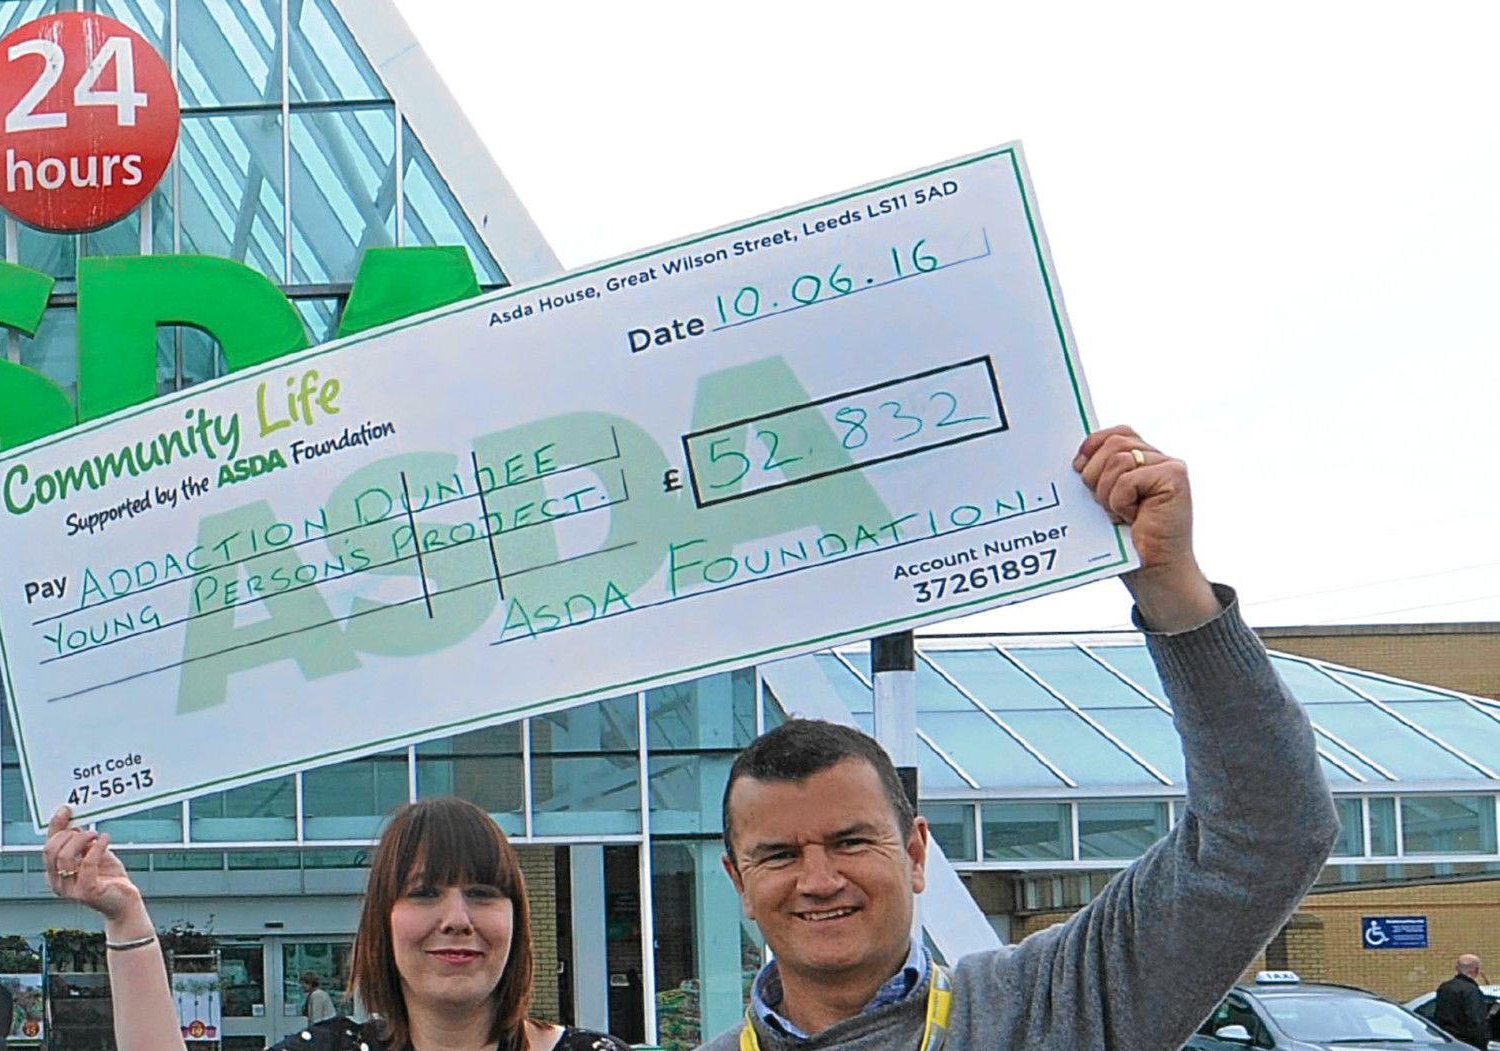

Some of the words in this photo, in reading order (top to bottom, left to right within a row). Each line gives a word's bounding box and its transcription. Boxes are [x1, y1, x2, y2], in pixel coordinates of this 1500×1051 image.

[4, 36, 148, 133] 24
[5, 148, 143, 192] hours
[488, 304, 534, 327] Asda
[538, 286, 600, 313] House,
[606, 267, 658, 292] Great
[662, 247, 728, 275] Wilson
[732, 228, 798, 256] Street,
[802, 210, 862, 237] Leeds
[867, 194, 909, 219] LS11
[914, 180, 959, 205] 5AD
[627, 317, 705, 354] Date
[2, 407, 241, 515] Community
[257, 369, 342, 437] Life
[65, 489, 152, 536] Supported
[154, 486, 178, 509] by
[180, 474, 210, 502] the
[216, 447, 288, 489] ASDA
[289, 419, 397, 466] Foundation
[80, 507, 330, 608] ADDACTION
[354, 443, 558, 524] DUNDEE
[893, 547, 978, 581] Account
[983, 524, 1069, 558] Number
[23, 576, 68, 605] Pay
[912, 547, 1058, 604] 37261897
[42, 604, 162, 655] YOUNG
[499, 580, 635, 640] ASDA
[67, 768, 154, 806] 47-56-13
[73, 763, 102, 780] Sort
[105, 752, 142, 772] Code
